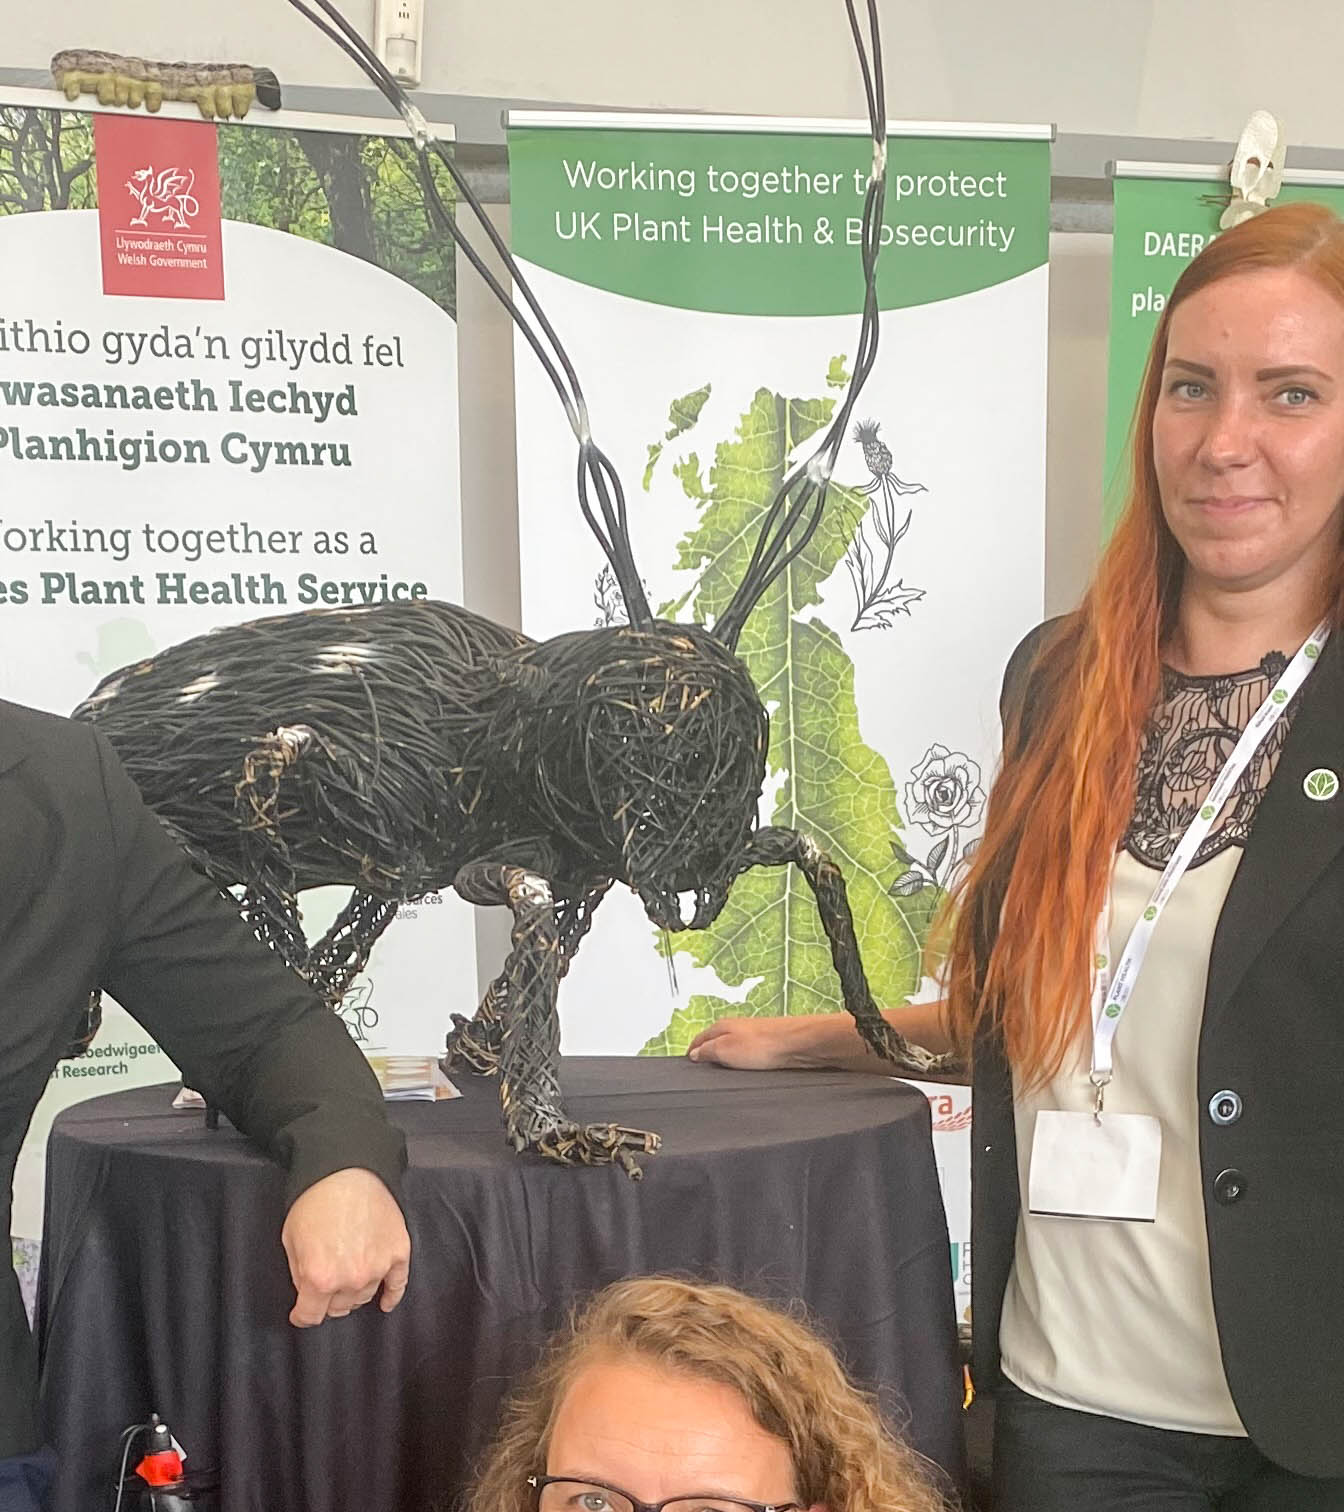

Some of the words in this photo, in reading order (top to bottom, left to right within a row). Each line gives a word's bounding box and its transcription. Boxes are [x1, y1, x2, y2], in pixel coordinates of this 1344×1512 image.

[562, 159, 696, 195] Working
[707, 165, 843, 199] together
[896, 171, 1007, 201] protect
[176, 239, 207, 255] Cymru
[555, 211, 602, 241] UK
[613, 212, 691, 242] Plant
[702, 214, 803, 245] Health
[813, 217, 834, 245] &
[846, 218, 1015, 251] Bosecurity
[117, 253, 147, 265] Welsh
[149, 254, 208, 269] Government
[102, 324, 230, 364] gyda'n
[241, 328, 354, 370] gilydd
[362, 334, 405, 368] fel
[229, 380, 358, 423] Iechyd
[220, 432, 353, 473] Cymru
[142, 521, 303, 559] together
[313, 532, 350, 555] as
[359, 533, 378, 555] a
[41, 571, 145, 605] Plant
[156, 571, 287, 605] Health
[297, 573, 429, 603] Service
[62, 1061, 129, 1078] Research
